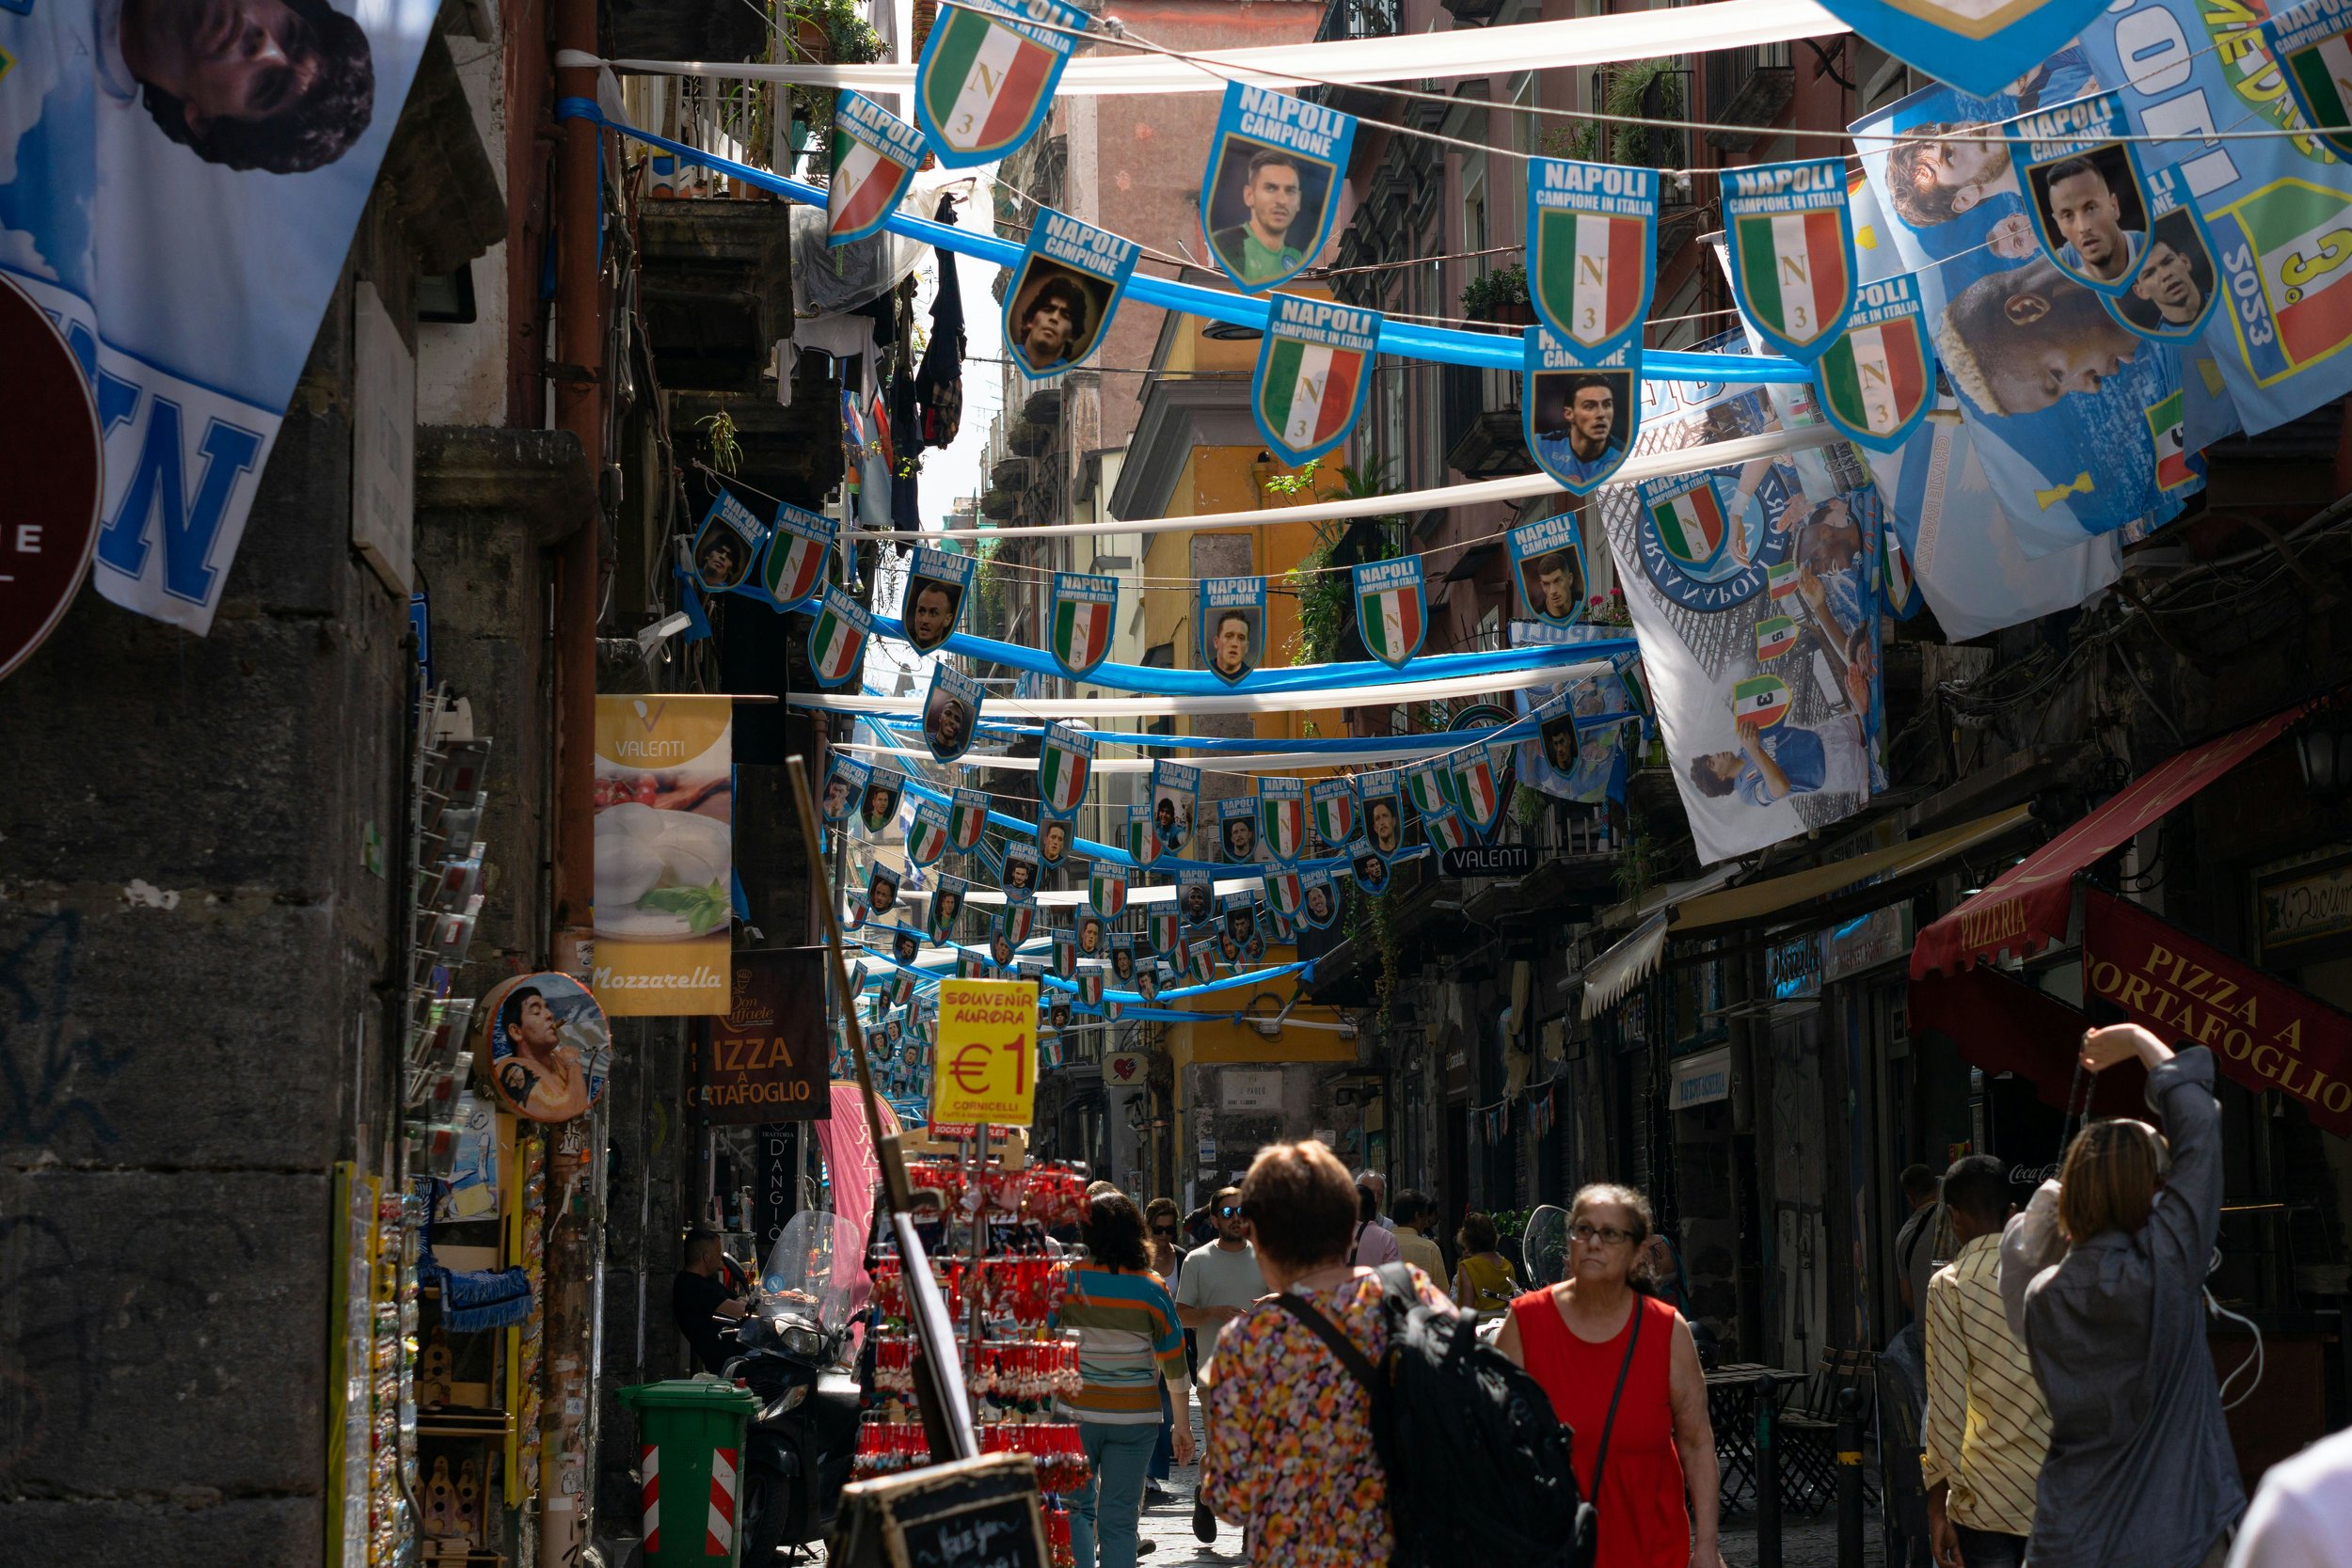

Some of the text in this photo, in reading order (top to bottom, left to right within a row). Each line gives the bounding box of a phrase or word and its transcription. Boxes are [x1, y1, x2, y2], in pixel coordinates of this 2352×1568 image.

[2274, 0, 2352, 38] NAPO
[1029, 23, 1072, 54] ITALIA
[2273, 19, 2331, 55] CAMPIONE
[968, 62, 1005, 99] N
[1238, 84, 1345, 140] NAPOLI
[2017, 97, 2114, 142] NAPOLI
[846, 96, 925, 154] NAPOLI
[957, 114, 975, 136] 3
[1239, 112, 1333, 158] CAMPIONE
[834, 111, 919, 171] CAMPIONE IN ITALIA
[2029, 122, 2112, 163] CAMPIONE
[836, 167, 862, 198] N
[1545, 163, 1648, 198] NAPOLI
[1735, 165, 1836, 197] NAPOLI
[1535, 190, 1654, 216] CAMPIONE IN ITALIA
[1728, 191, 1846, 214] CAMPIONE IN ITALIA
[1045, 214, 1133, 263] NAPOLI
[1044, 236, 1120, 277] CAMPIONE
[1579, 255, 1607, 287] N
[1780, 255, 1810, 287] N
[1853, 278, 1909, 311] POLI
[1280, 299, 1372, 336] NAPOLI
[1582, 308, 1597, 329] 3
[1794, 307, 1807, 328] 3
[1869, 305, 1883, 321] IN
[1883, 299, 1920, 318] ITALIA
[1272, 321, 1375, 351] CAMPIONE IN ITALIA
[1860, 360, 1886, 389] N
[1298, 377, 1323, 404] N
[1875, 404, 1889, 424] 3
[1293, 420, 1307, 437] 3
[1646, 472, 1711, 509] CAMPIONE IN ITALIA
[722, 508, 757, 543] CAMPIONE
[723, 495, 765, 538] NAPOLI
[783, 507, 832, 534] NAPOLI
[1681, 515, 1700, 535] N
[777, 519, 807, 536] CAMPIONE
[812, 530, 832, 544] ITALIA
[1515, 516, 1571, 546] NAPOLI
[1521, 531, 1570, 556] CAMPIONE
[1693, 542, 1705, 555] 3
[787, 554, 802, 574] N
[918, 548, 969, 573] NAPOLI
[1359, 561, 1415, 584] NAPOLI
[918, 564, 962, 583] CAMPIONE
[1061, 575, 1113, 594] NAPOLI
[1358, 576, 1420, 594] CAMPIONE IN ITALIA
[1056, 590, 1117, 603] CAMPIONE IN ITALIA
[1206, 578, 1261, 595] NAPOLI
[830, 590, 872, 626] NAPOLI
[1210, 593, 1257, 607] CAMPIONE
[1073, 624, 1089, 641] N
[1385, 612, 1401, 631] N
[829, 638, 843, 656] N
[942, 667, 981, 699] NAPOLI
[942, 679, 975, 705] CAMPIONE
[615, 739, 685, 757] VALENTI
[1050, 725, 1089, 750] NAPOLI
[837, 759, 868, 783] NAPOLI
[872, 768, 904, 784] NAPOLI
[1159, 762, 1198, 783] NAPOLI
[1159, 773, 1193, 791] CAMPIONE
[1361, 772, 1396, 789] NAPOLI
[957, 791, 989, 803] NAPOLI
[1263, 779, 1302, 791] NAPOLI
[1313, 780, 1348, 796] NAPOLI
[1221, 798, 1255, 810] NAPOLI
[1093, 863, 1127, 876] NAPOLI
[1453, 848, 1528, 869] VALENTI
[1179, 870, 1212, 879] NAPOLI
[1300, 868, 1328, 885] NAPOLI
[1960, 896, 2027, 952] PIZZERIA
[592, 966, 723, 990] Mozzarella
[945, 987, 1034, 1008] SOUVENIR
[2141, 942, 2302, 1053] PIZZA A
[954, 1008, 1025, 1025] AURORA
[737, 1071, 750, 1085] A
[687, 1080, 810, 1107] RTAFOGLIO
[953, 1101, 1019, 1112] CORNICELLI
[762, 1131, 794, 1139] TRATTORIA
[934, 1125, 961, 1135] SOCKS
[962, 1126, 975, 1135] OF
